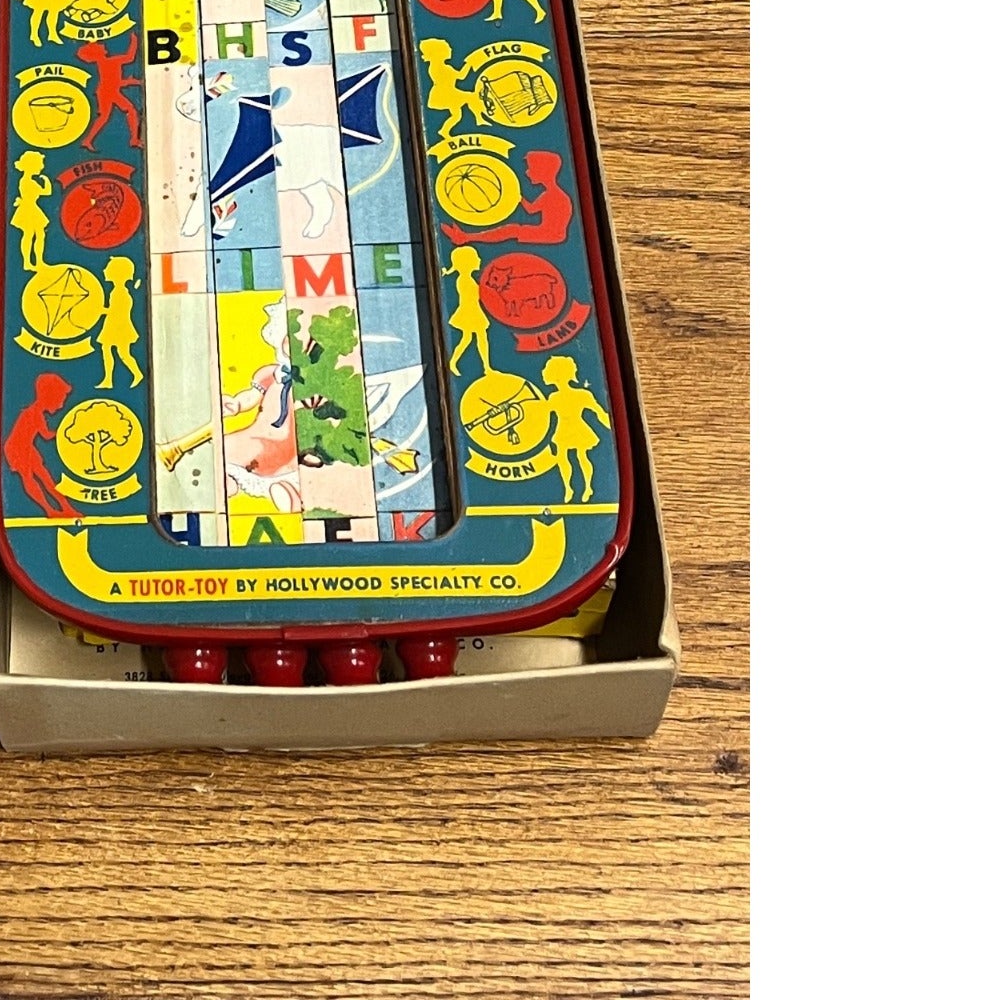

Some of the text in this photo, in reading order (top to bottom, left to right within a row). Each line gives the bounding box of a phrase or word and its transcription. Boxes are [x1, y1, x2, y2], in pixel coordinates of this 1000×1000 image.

[77, 28, 112, 39] BABY
[483, 43, 522, 58] FLAG
[34, 67, 65, 77] PAIL
[448, 136, 482, 150] BALL
[72, 162, 103, 177] FISH
[161, 243, 403, 298] LIME
[537, 319, 578, 347] LAMB
[30, 341, 61, 358] KITE
[485, 461, 536, 478] HORN
[80, 488, 118, 501] TREE
[110, 574, 522, 597] A TUTOR-TOY BY HOLLYWOOD SPECIALTY CO.
